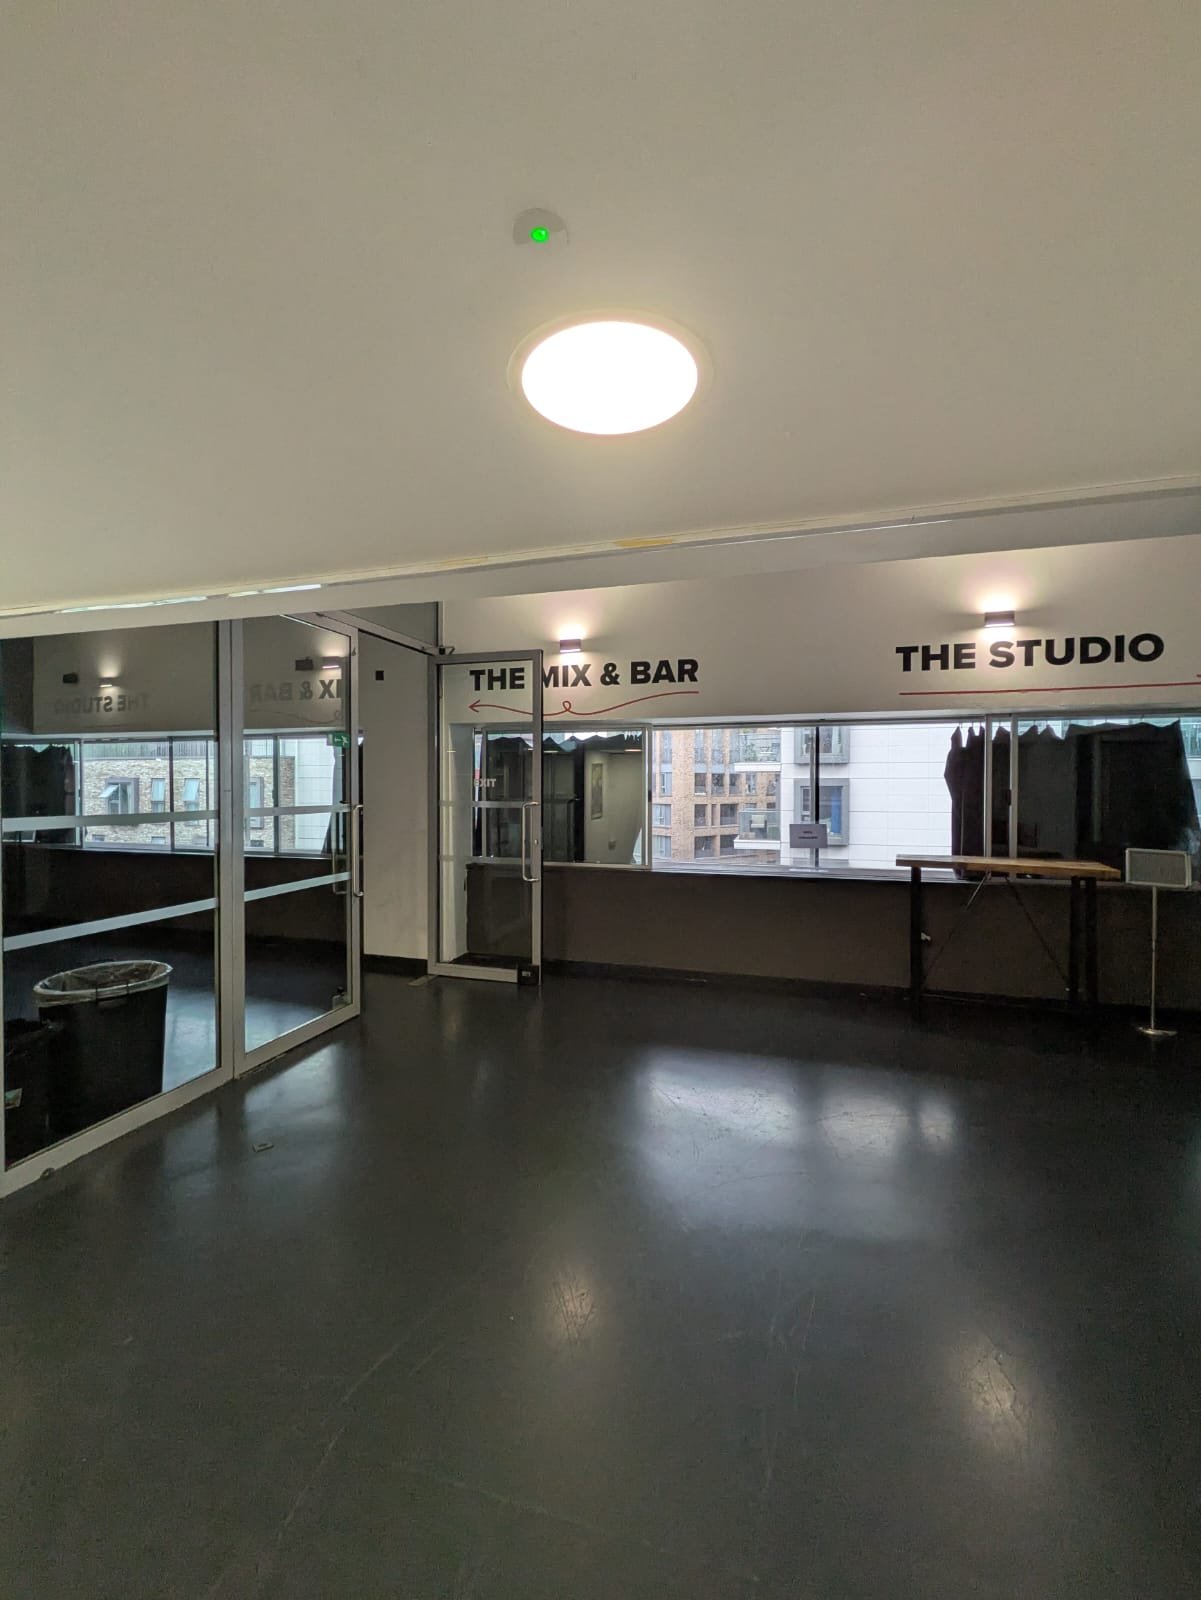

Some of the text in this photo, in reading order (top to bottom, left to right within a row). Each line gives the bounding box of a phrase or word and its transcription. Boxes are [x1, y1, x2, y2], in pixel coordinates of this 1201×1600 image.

[895, 633, 1165, 672] THE STUDIO
[469, 659, 699, 691] THE MIX & BAR
[474, 778, 497, 788] EXIT
